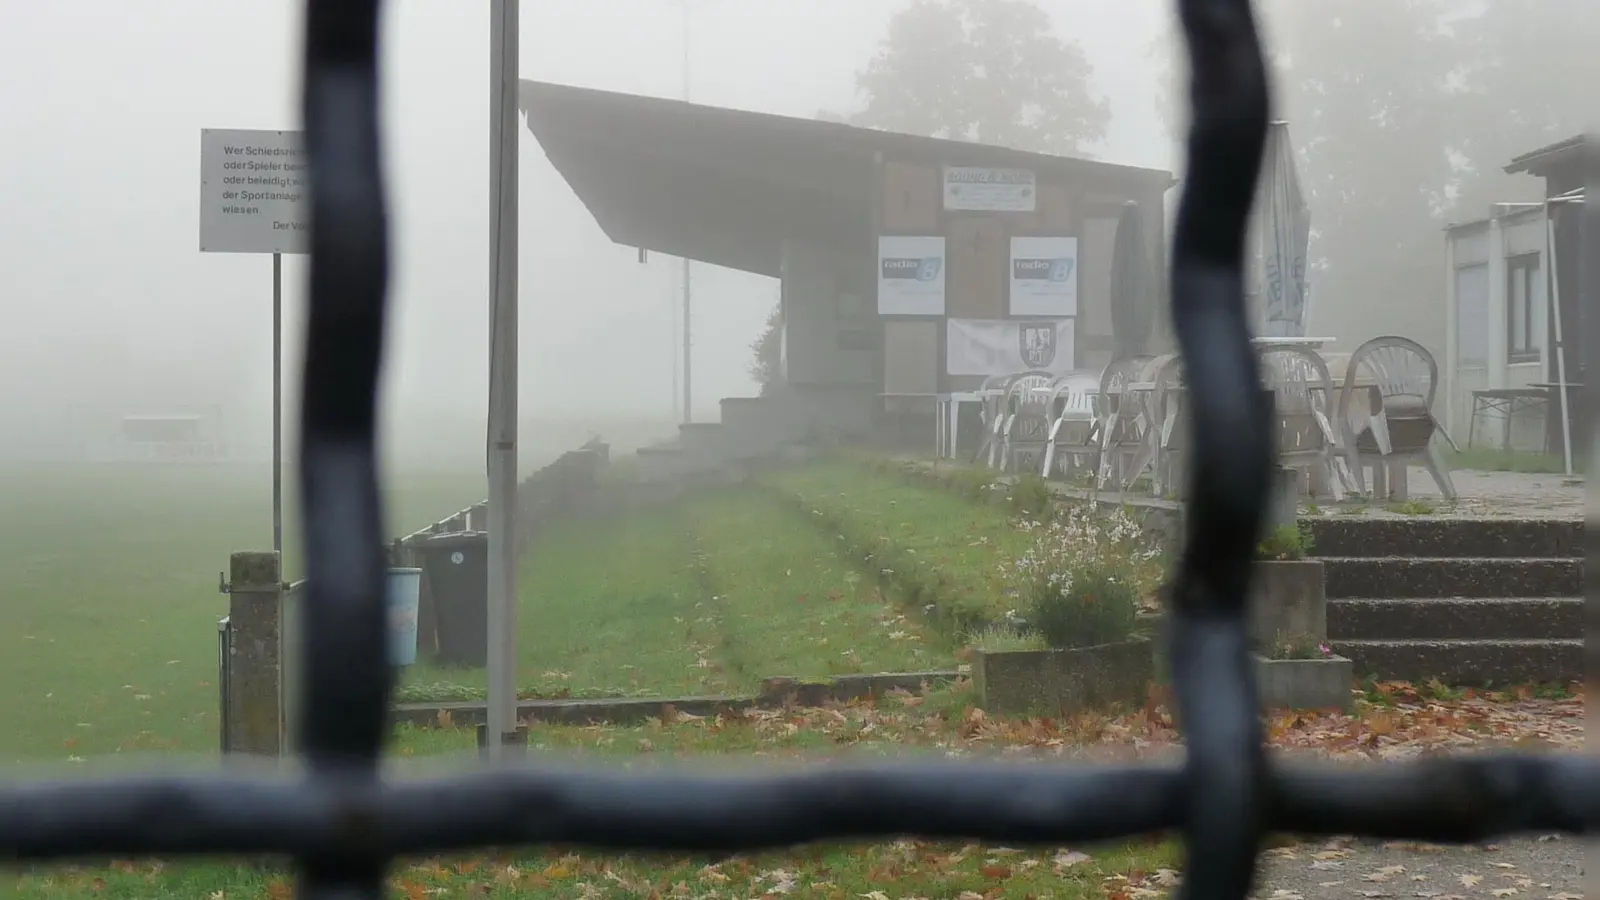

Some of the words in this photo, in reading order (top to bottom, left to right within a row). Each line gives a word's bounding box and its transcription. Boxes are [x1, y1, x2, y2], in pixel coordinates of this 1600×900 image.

[224, 146, 244, 156] Wer
[223, 161, 245, 170] oder
[247, 161, 282, 171] Spieler
[223, 176, 245, 184] oder
[247, 176, 292, 187] beleidigt,
[222, 190, 238, 199] der
[273, 221, 290, 230] Der
[291, 221, 307, 230] Vo
[884, 260, 918, 268] radio
[922, 262, 936, 280] 8
[1016, 260, 1050, 269] radio
[1054, 262, 1068, 280] 8
